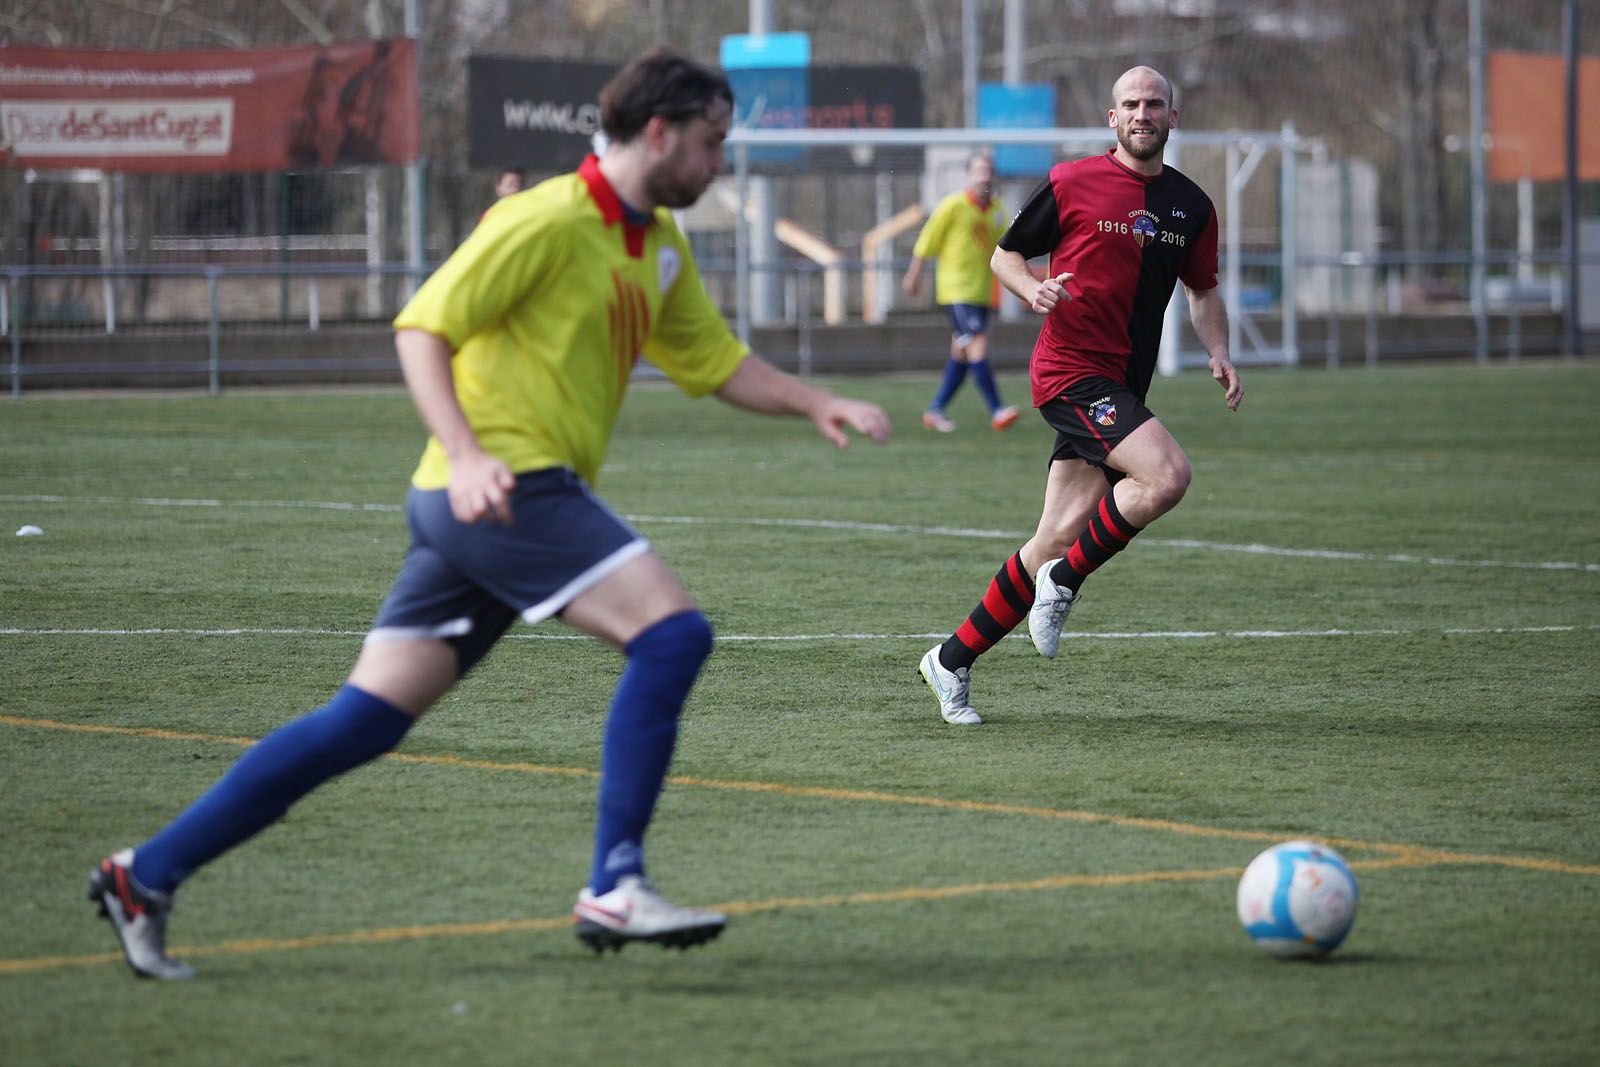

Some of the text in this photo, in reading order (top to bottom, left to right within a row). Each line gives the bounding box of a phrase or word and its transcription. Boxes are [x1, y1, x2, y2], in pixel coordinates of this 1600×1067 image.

[1128, 209, 1160, 224] CENTENARI
[1096, 220, 1186, 247] 1916 2016
[1089, 397, 1110, 415] CETENARI
